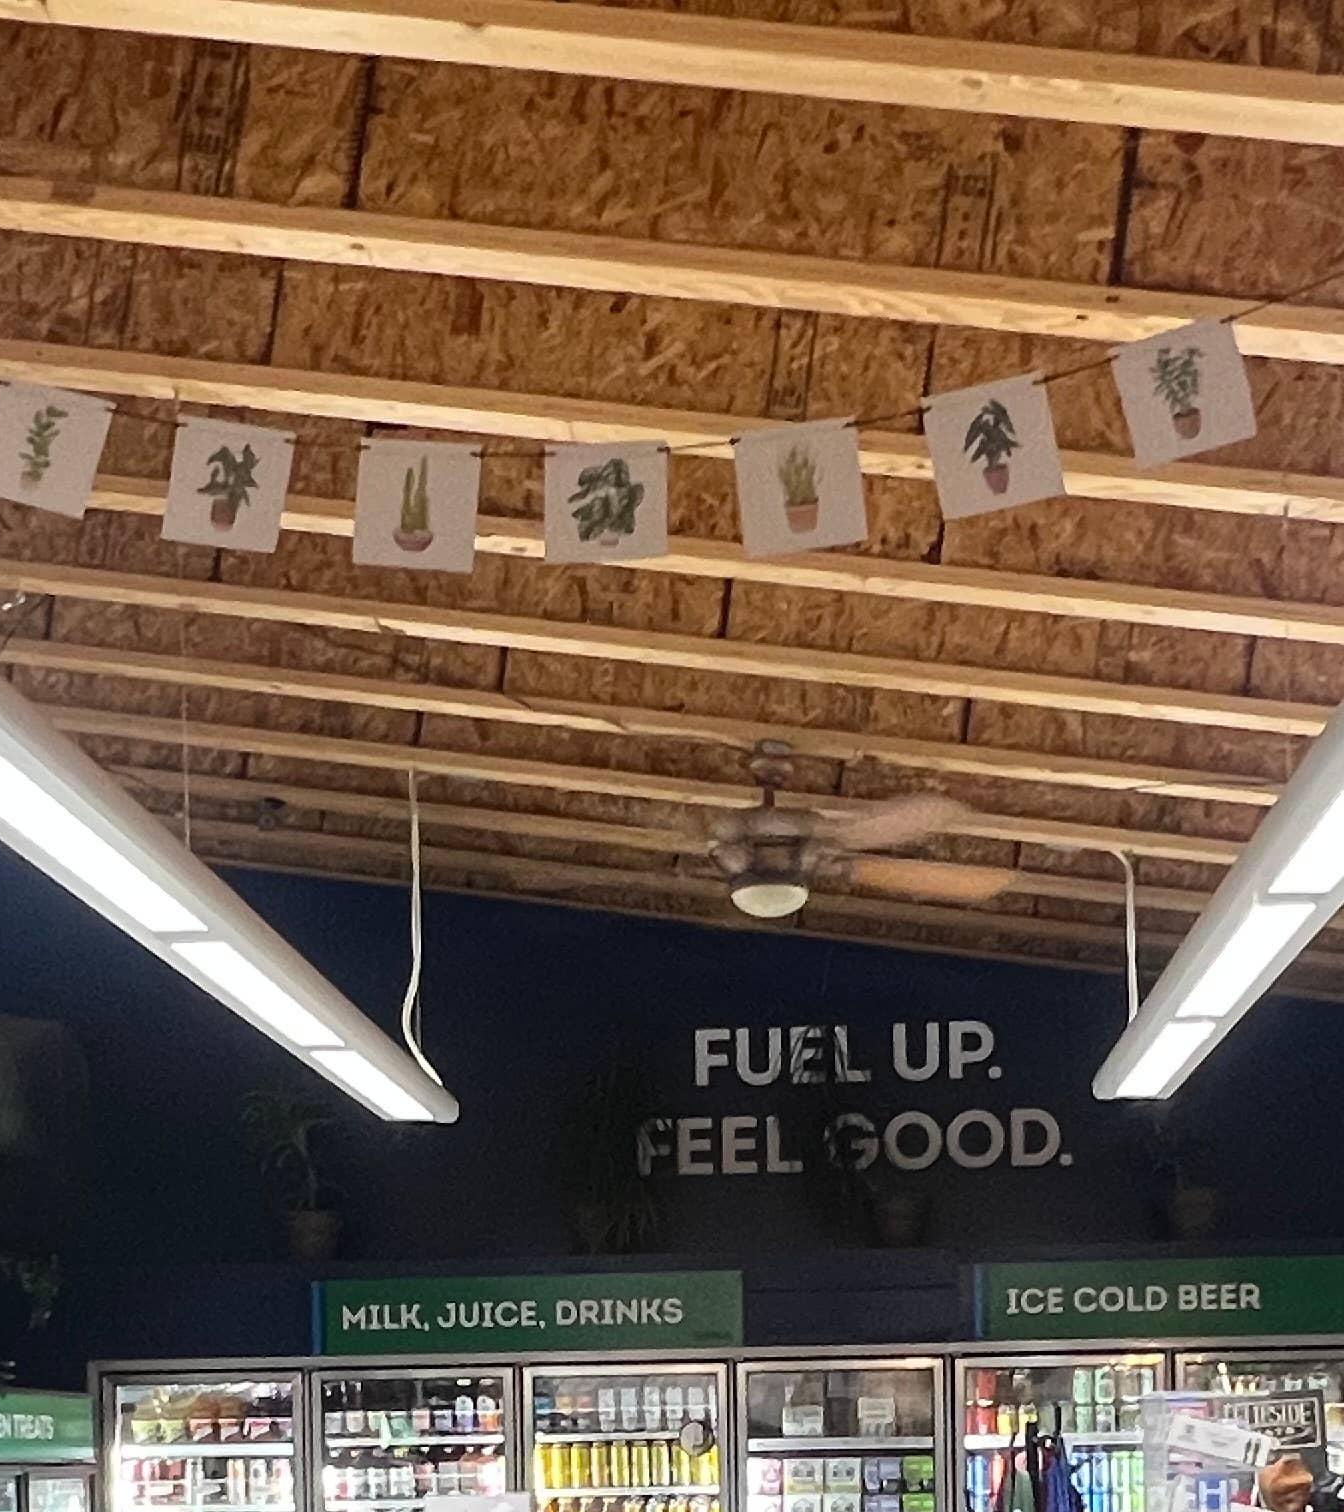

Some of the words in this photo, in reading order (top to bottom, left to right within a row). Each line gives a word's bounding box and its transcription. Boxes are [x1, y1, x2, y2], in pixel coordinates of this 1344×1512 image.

[692, 1024, 871, 1086] FUEL
[892, 1020, 1002, 1081] UP.
[636, 1115, 803, 1176] FEEL
[824, 1108, 1073, 1170] GOOD.
[342, 1304, 430, 1332] MILK,
[437, 1300, 546, 1330] JUICE,
[556, 1297, 684, 1325] DRINKS
[1006, 1287, 1064, 1315] ICE
[1073, 1285, 1168, 1313] COLD
[1177, 1283, 1261, 1311] BEER
[13, 1414, 54, 1440] TREATS
